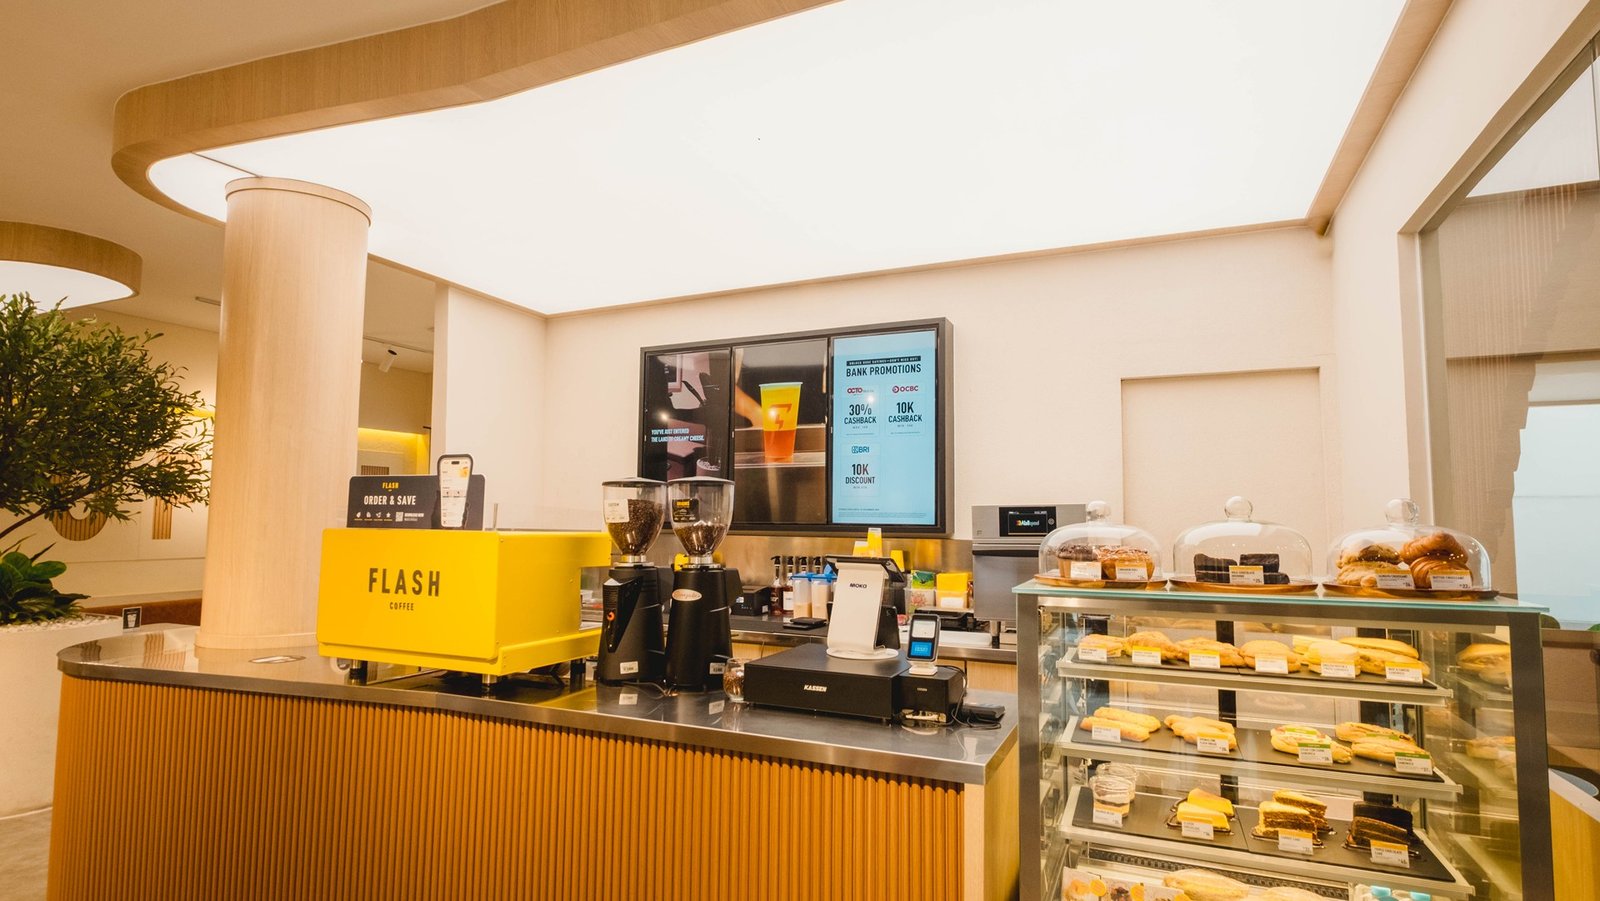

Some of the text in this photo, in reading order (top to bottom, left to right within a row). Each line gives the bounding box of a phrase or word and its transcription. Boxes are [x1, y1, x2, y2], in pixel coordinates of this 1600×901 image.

[846, 363, 921, 377] BANK PROMOTIONS
[848, 404, 872, 416] 30%
[896, 401, 914, 414] 10K
[844, 416, 877, 425] CASHBACK
[888, 414, 922, 423] CASHBACK
[852, 463, 869, 475] 10K
[845, 476, 875, 484] DISCOUNT
[363, 495, 417, 505] ORDER & SAVE
[368, 567, 440, 597] FLASH
[389, 601, 414, 611] COFFEE
[803, 684, 828, 692] KASSEN
